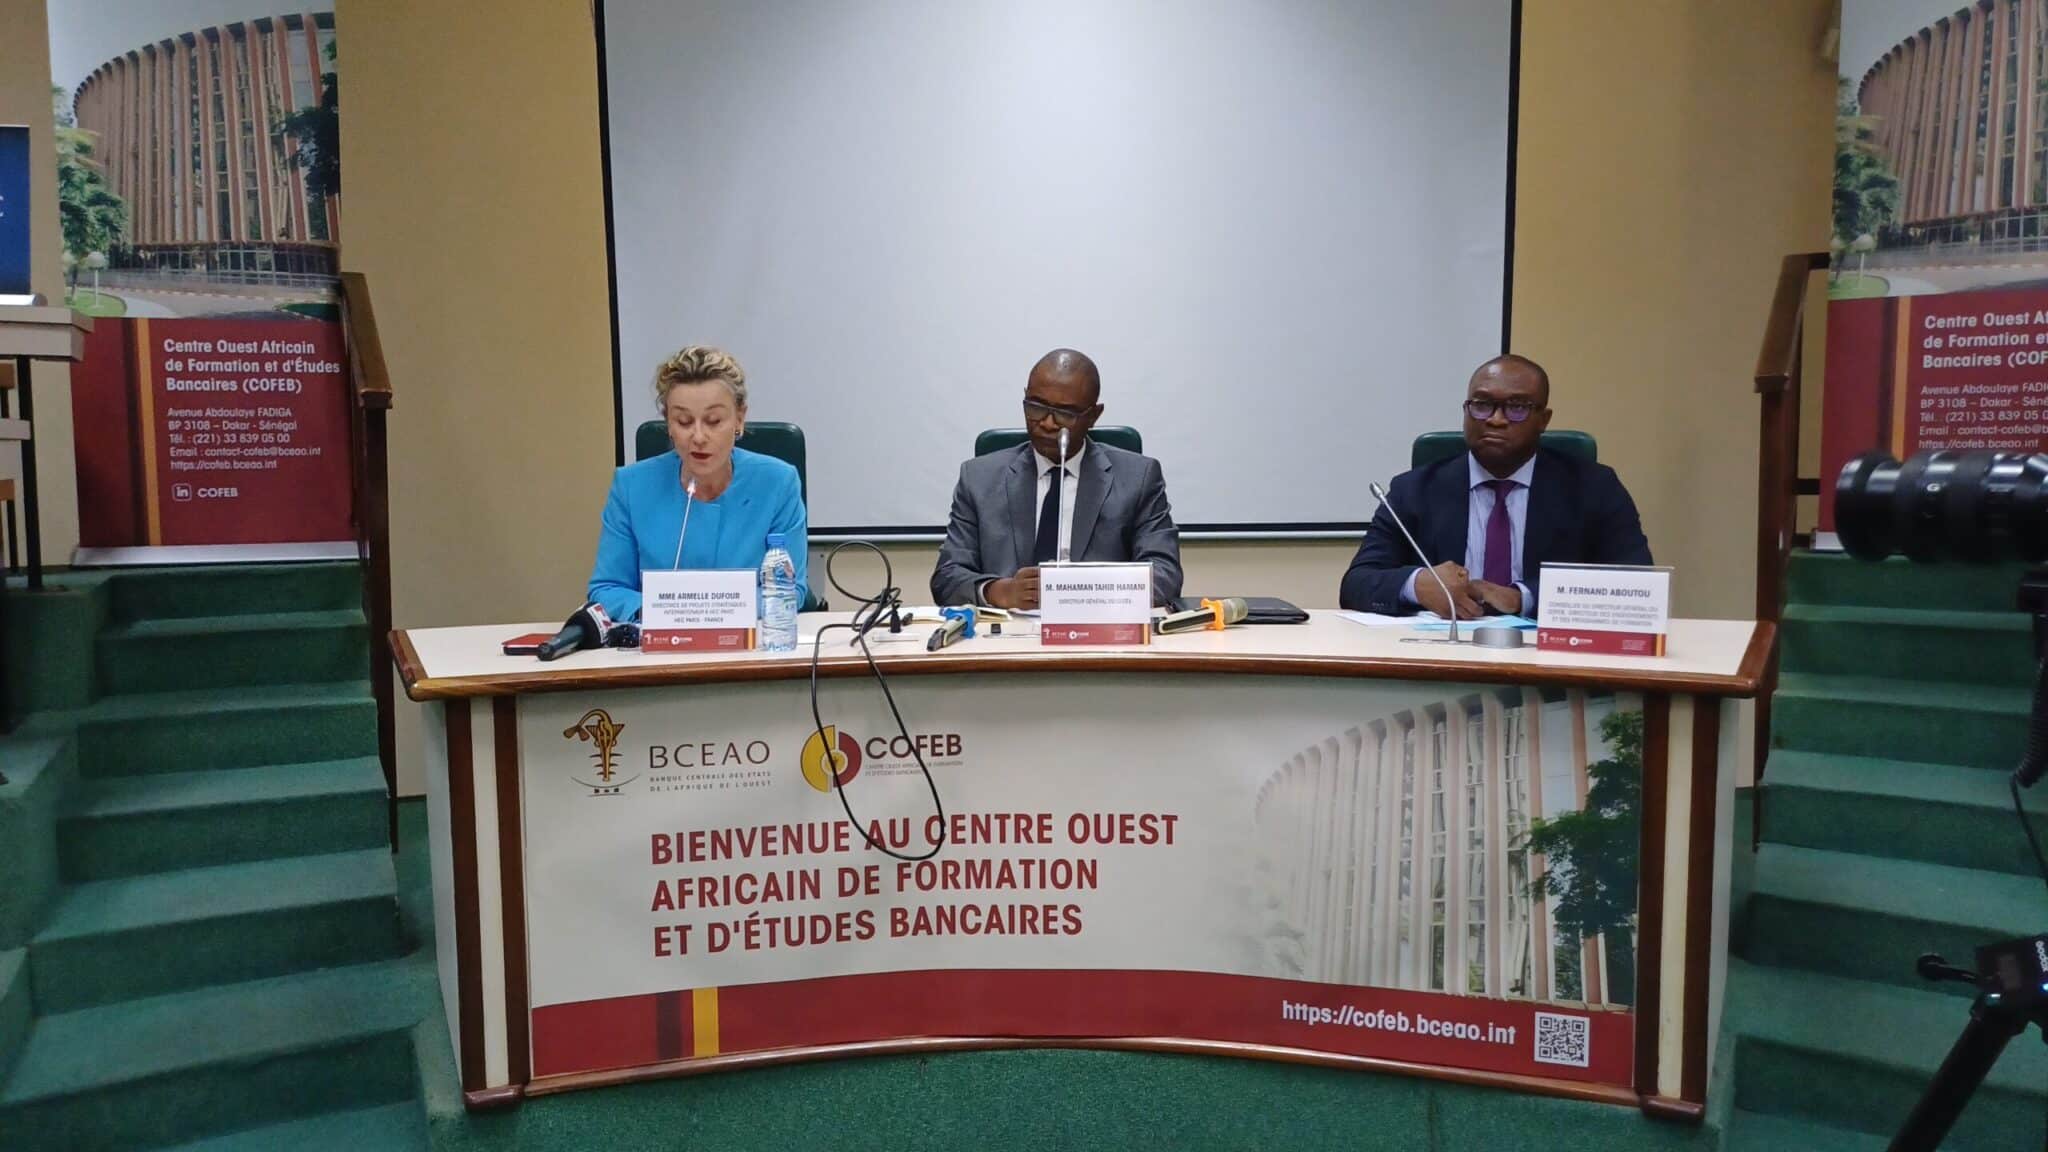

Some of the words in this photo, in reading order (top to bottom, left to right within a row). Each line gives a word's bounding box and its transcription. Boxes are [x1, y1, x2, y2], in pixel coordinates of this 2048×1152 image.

[1924, 315, 1977, 329] Centre
[1983, 312, 2029, 327] Ouest
[164, 339, 213, 353] Centre
[217, 339, 258, 353] Ouest
[260, 340, 315, 354] Africain
[1923, 335, 1943, 349] de
[1948, 331, 2029, 348] Formation
[165, 358, 184, 372] de
[188, 358, 260, 373] Formation
[264, 360, 279, 373] et
[282, 357, 340, 373] d'Études
[1923, 353, 2002, 369] Bancaires
[166, 378, 238, 391] Bancaires
[242, 378, 302, 394] (COFEB)
[1920, 385, 1959, 395] Avenue
[1961, 383, 2019, 395] Abdoulaye
[1920, 398, 1935, 408] BP
[1937, 398, 1967, 408] 3108
[1980, 397, 2011, 408] Dakar
[167, 407, 203, 417] Avenue
[205, 407, 255, 419] Abdoulaye
[257, 408, 292, 417] FADIGA
[1945, 411, 1977, 424] (221)
[1979, 411, 1994, 421] 33
[1998, 410, 2021, 421] 839
[2023, 410, 2039, 420] 05
[168, 420, 181, 430] BP
[184, 420, 211, 430] 3108
[222, 420, 251, 430] Dakar
[259, 420, 298, 432] Sénégal
[1919, 426, 1949, 436] Email
[192, 433, 221, 445] (221)
[223, 433, 237, 443] 33
[261, 433, 275, 443] 05
[277, 433, 290, 443] 00
[1918, 438, 2039, 450] https://cofeb.bceao.int
[170, 447, 198, 457] Email
[170, 460, 278, 472] https://cofeb.bceao.int
[197, 488, 238, 498] COFEB
[1056, 583, 1093, 591] MAHAMAN
[1094, 583, 1114, 591] TAHIR
[1116, 583, 1145, 591] HAMANI
[1569, 586, 1608, 596] FERNAND
[1610, 588, 1651, 598] ABOUTOU
[658, 592, 676, 600] MME
[677, 592, 709, 600] ARMELLE
[711, 592, 740, 600] DUFOUR
[865, 734, 962, 760] COFEB
[650, 740, 770, 769] BCEAO
[651, 820, 851, 865] BIENVENUE
[864, 817, 911, 850] AU
[925, 813, 1053, 848] CENTRE
[1067, 813, 1178, 845] OUEST
[651, 868, 822, 912] AFRICAIN
[838, 864, 881, 898] DE
[896, 858, 1099, 893] FORMATION
[653, 924, 692, 957] ET
[707, 909, 876, 953] D'ÉTUDES
[889, 903, 1083, 938] BANCAIRES
[1282, 1000, 1516, 1045] https://cofeb.bceao.int
